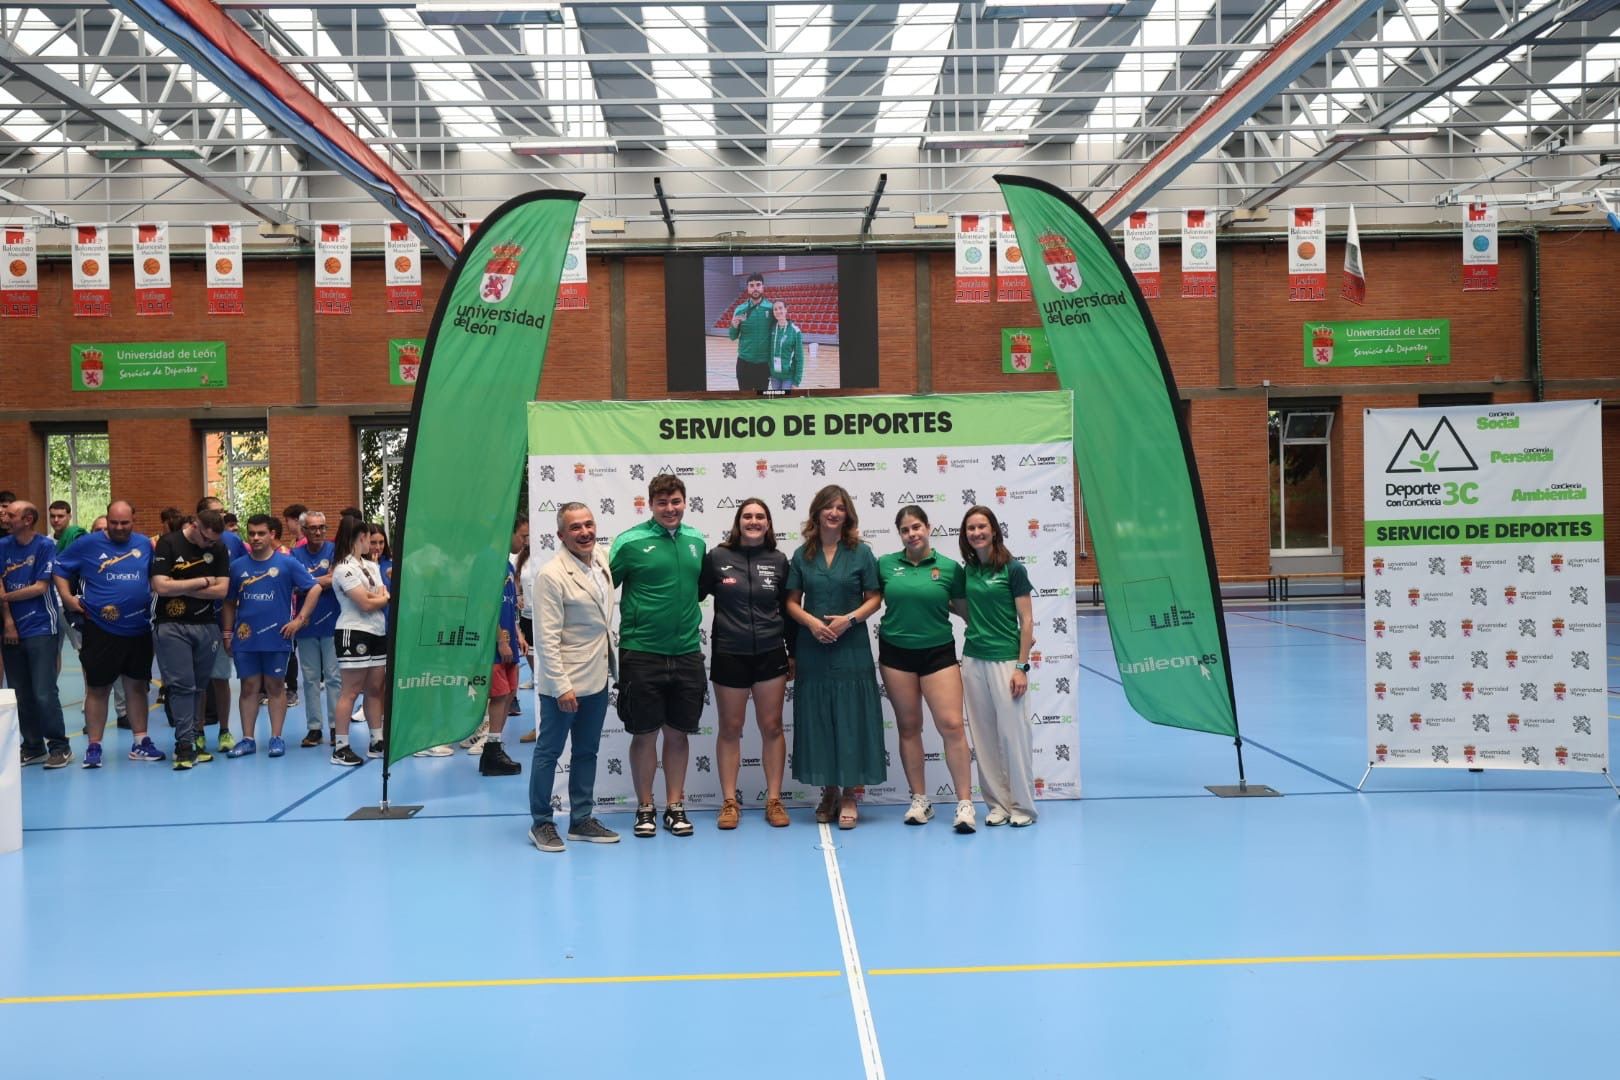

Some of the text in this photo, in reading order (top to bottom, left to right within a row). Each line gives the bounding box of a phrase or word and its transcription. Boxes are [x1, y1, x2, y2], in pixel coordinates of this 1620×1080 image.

[1042, 290, 1127, 314] universidad
[456, 304, 546, 329] universidad
[1058, 310, 1092, 326] león
[464, 316, 496, 336] león
[1346, 326, 1440, 337] Universidad de León
[117, 348, 216, 360] Universidad de León
[1354, 344, 1428, 358] Servicio de Deportes
[120, 366, 198, 380] Servicio de Deportes
[659, 411, 952, 440] SERVICIO DE DEPORTES
[1476, 416, 1520, 430] Social
[1490, 449, 1554, 464] Personal
[1385, 482, 1479, 506] Deporte 3C
[1402, 498, 1441, 506] ConCiencia
[1512, 487, 1586, 502] Ambiental
[1376, 521, 1592, 541] SERVICIO DE DEPORTES
[1120, 653, 1218, 674] unileon.es
[398, 672, 487, 689] unileon.es
